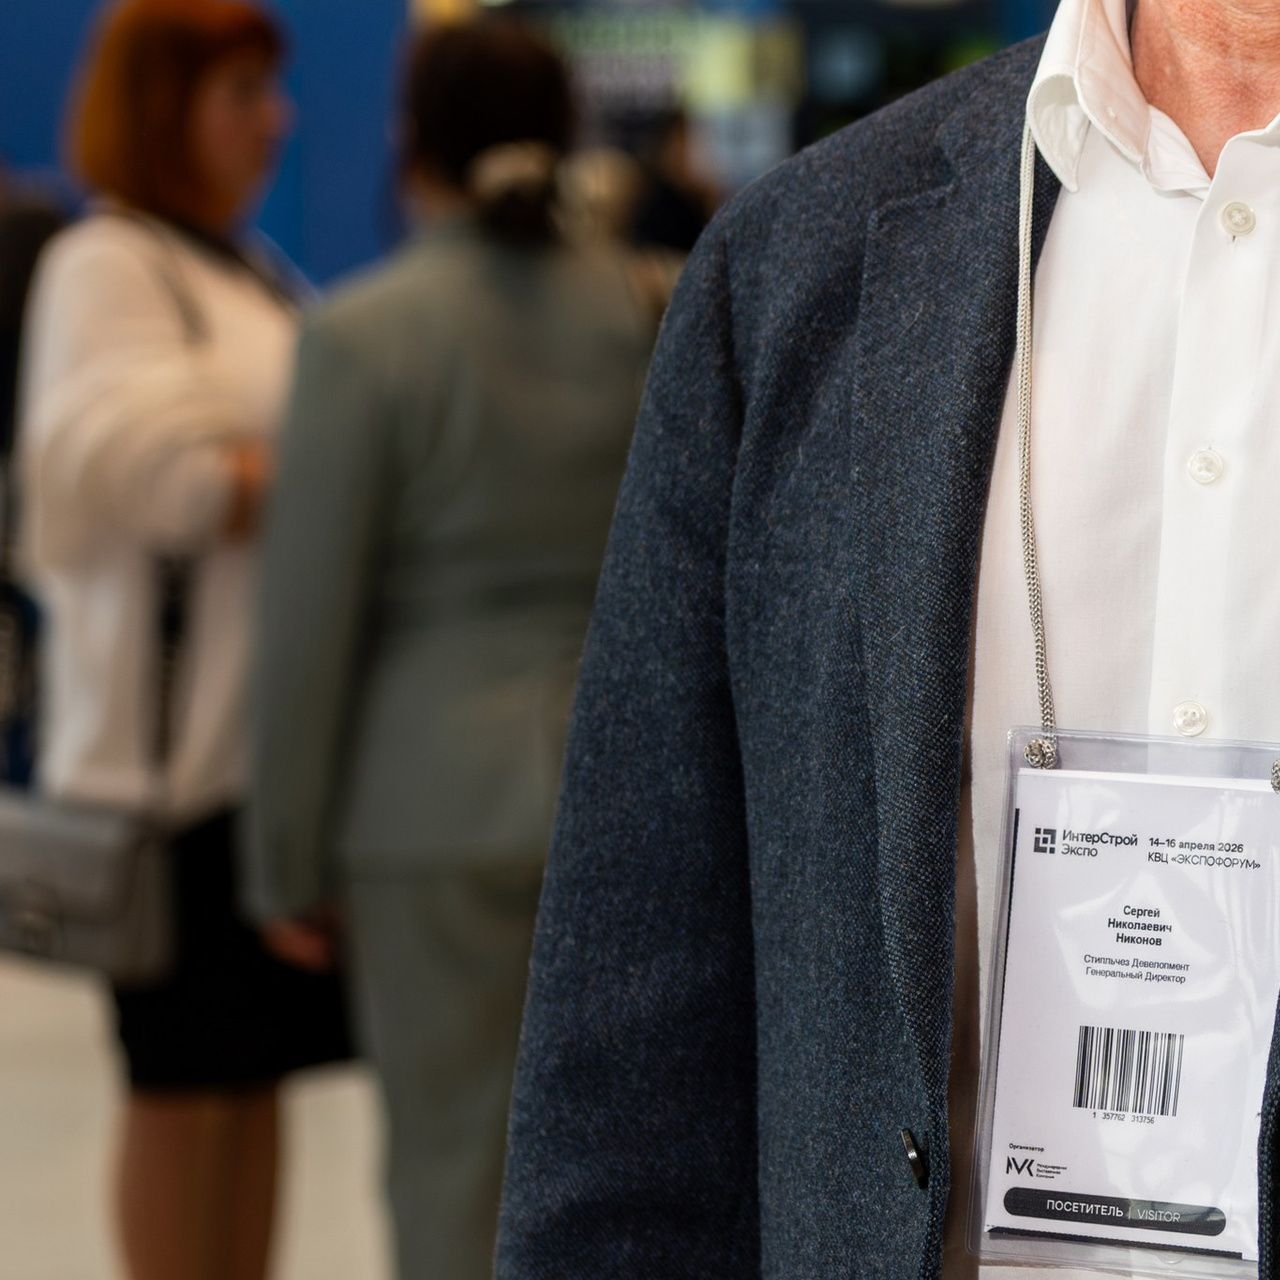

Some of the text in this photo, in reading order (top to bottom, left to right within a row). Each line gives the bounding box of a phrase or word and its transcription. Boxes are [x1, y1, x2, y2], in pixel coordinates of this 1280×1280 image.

[1062, 829, 1138, 846] ИнтерСтрой
[1061, 844, 1098, 857] Экспо
[1178, 841, 1215, 852] апреля
[1218, 842, 1244, 853] 2026
[1147, 852, 1168, 865] КВЦ
[1123, 905, 1160, 918] Сергей
[1107, 918, 1172, 932] Николаевич
[1116, 932, 1162, 946] Никонов
[1131, 958, 1190, 971] Девелопмент
[1085, 966, 1186, 984] Генеральный Директор
[1046, 1199, 1181, 1223] ПОСЕТИТЕЛЬ VISITOR
